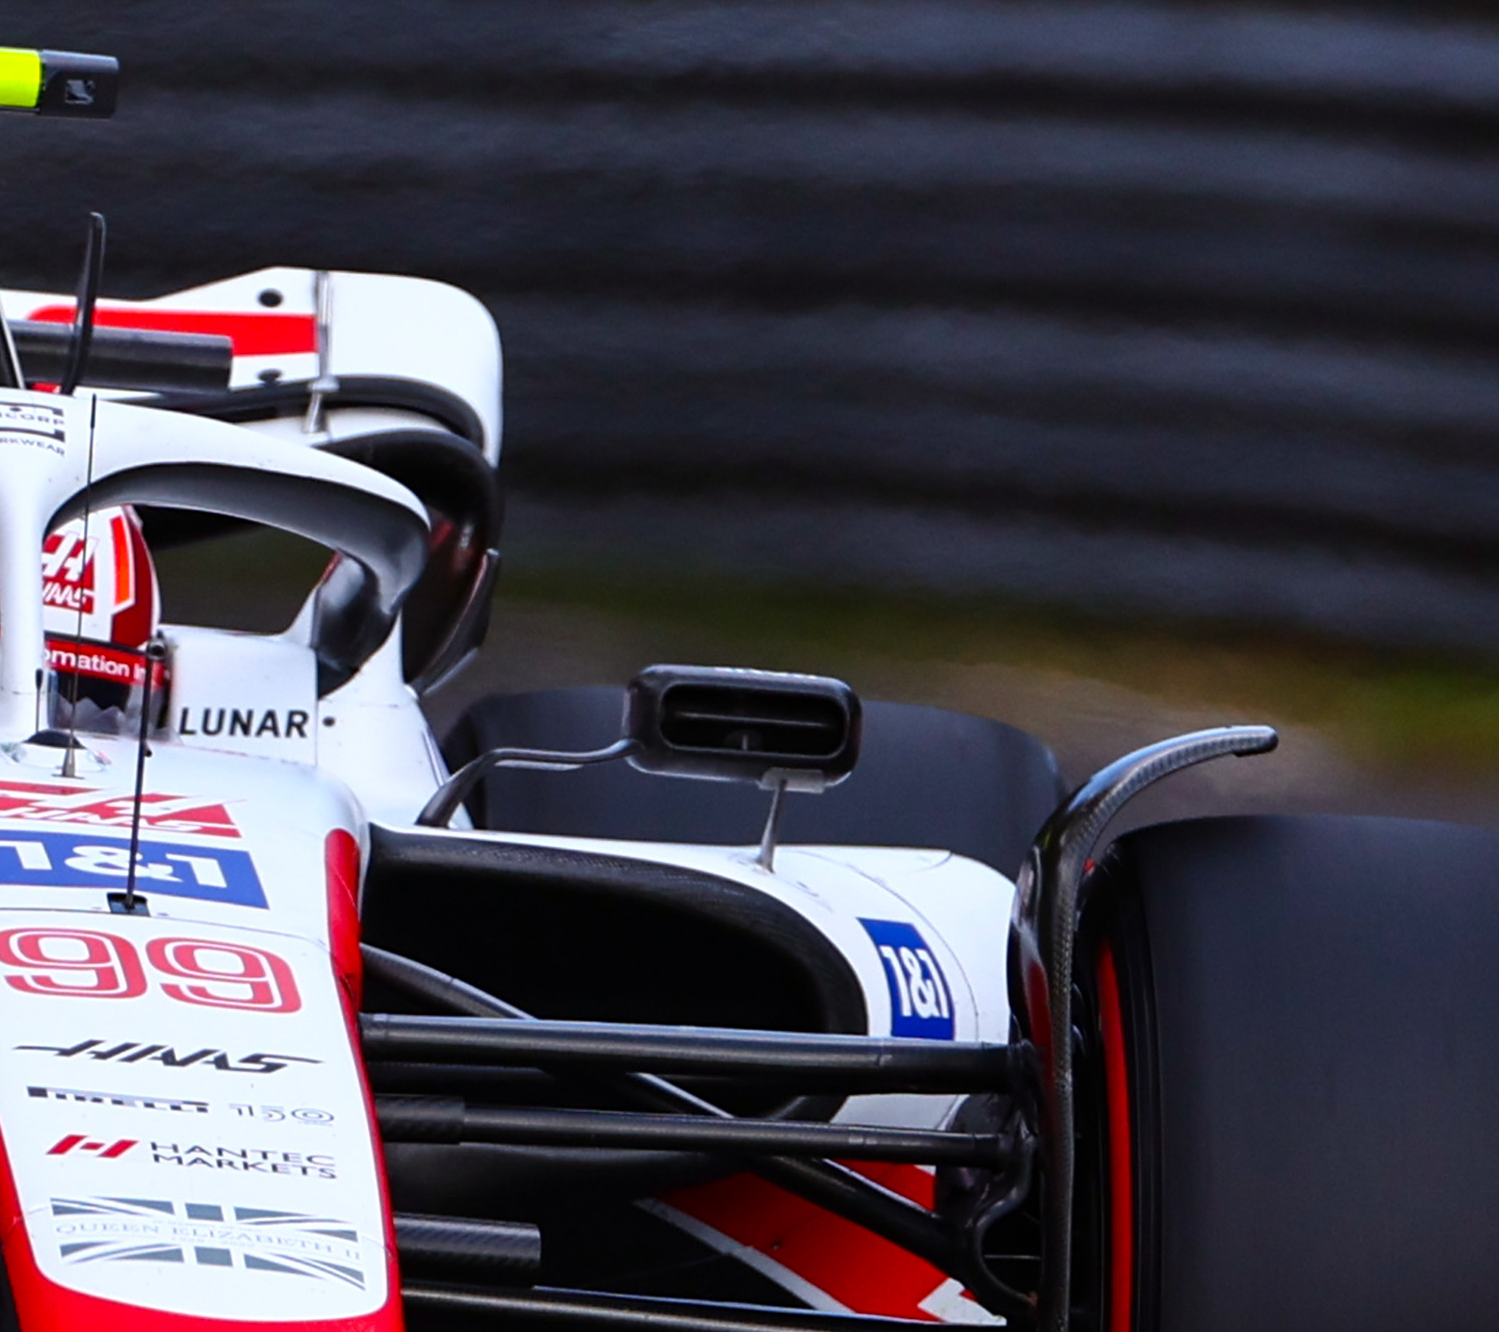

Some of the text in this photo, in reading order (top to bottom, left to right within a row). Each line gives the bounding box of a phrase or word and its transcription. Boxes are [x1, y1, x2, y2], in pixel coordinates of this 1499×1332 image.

[179, 707, 309, 738] LUNAR
[879, 944, 950, 1019] 1&1
[13, 1038, 325, 1073] HAAS
[150, 1141, 336, 1167] HANTEC
[152, 1154, 337, 1179] MARKETS
[56, 1223, 160, 1235] QUEEN
[172, 1225, 333, 1253] ELIZABETH
